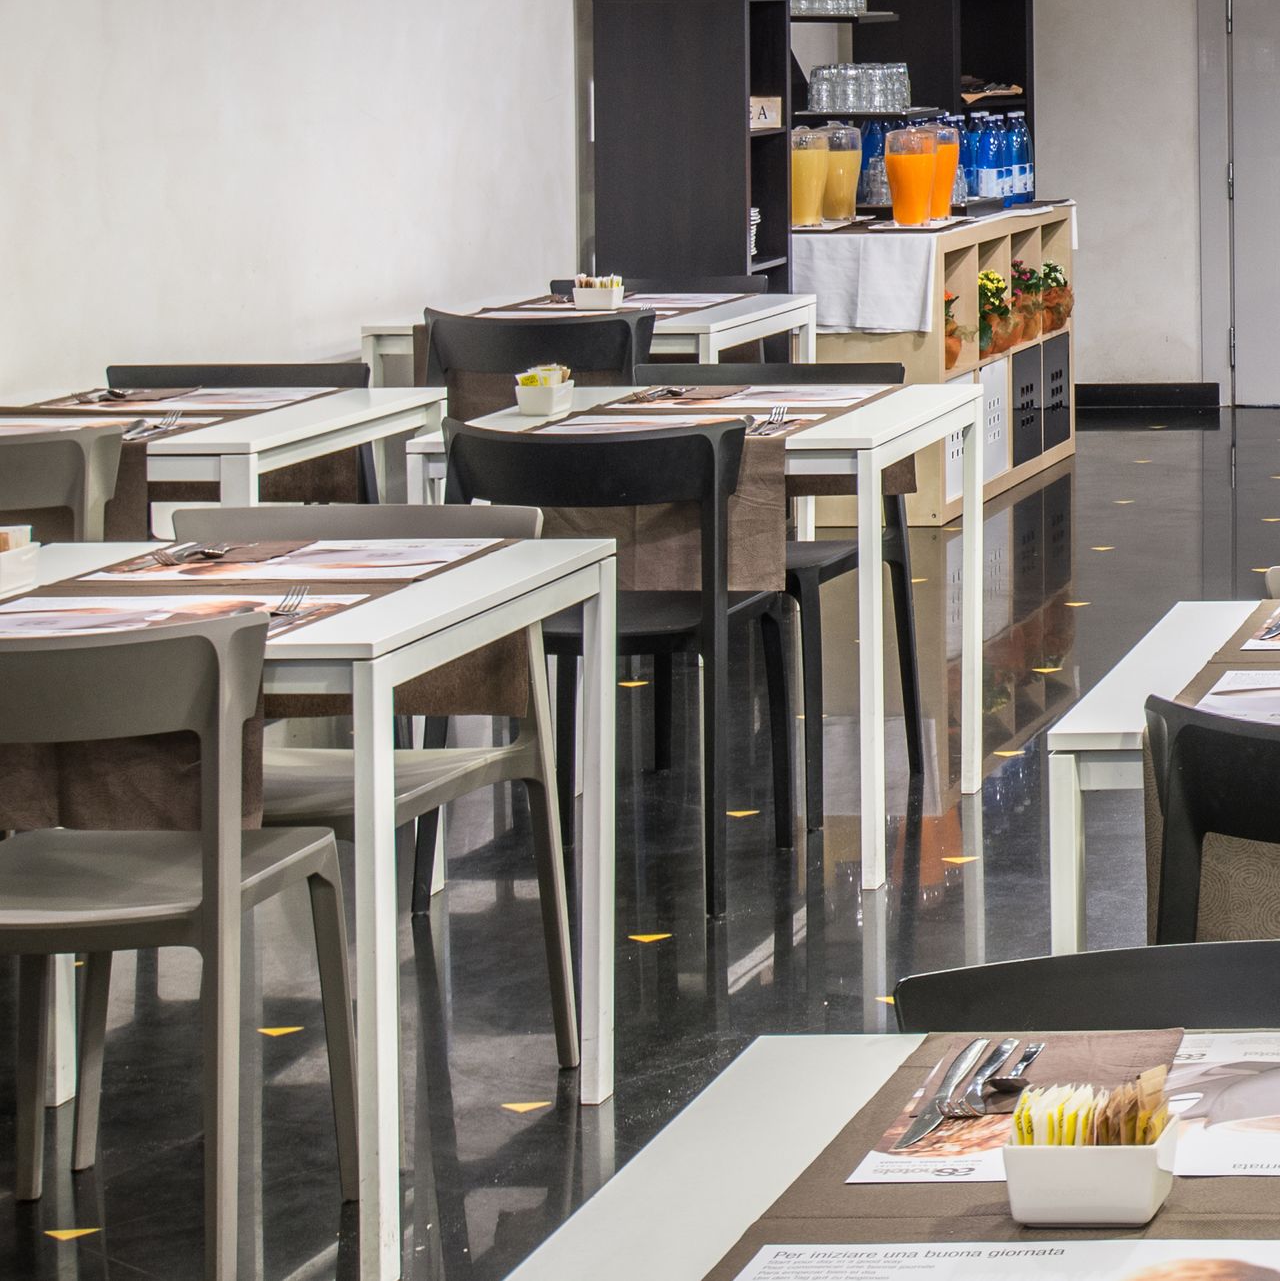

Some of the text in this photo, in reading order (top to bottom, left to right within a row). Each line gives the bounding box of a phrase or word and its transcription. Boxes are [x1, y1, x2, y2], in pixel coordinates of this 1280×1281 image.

[773, 1247, 1065, 1259] Per iniziare una buona giornata
